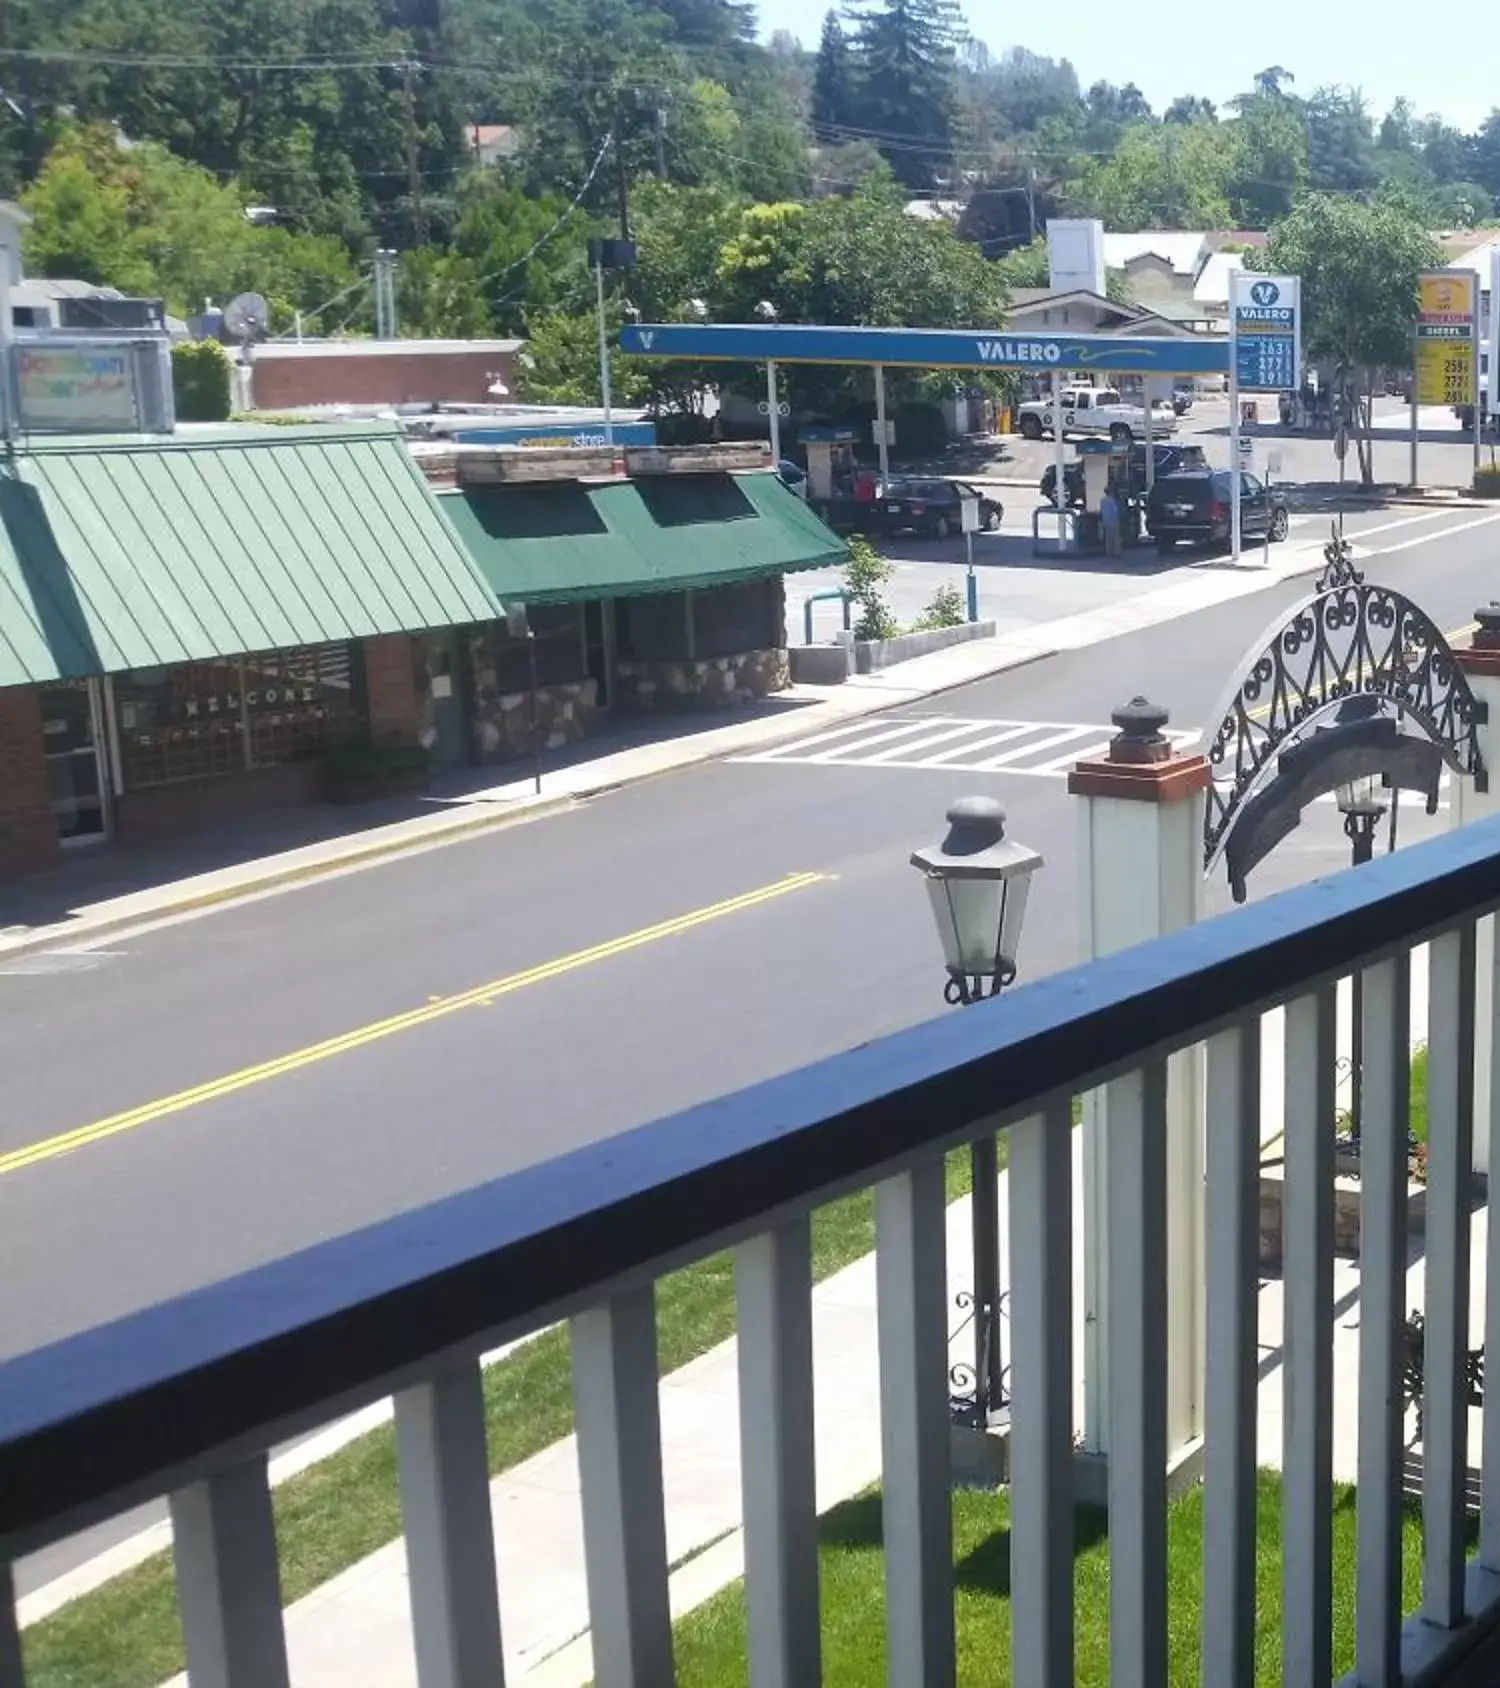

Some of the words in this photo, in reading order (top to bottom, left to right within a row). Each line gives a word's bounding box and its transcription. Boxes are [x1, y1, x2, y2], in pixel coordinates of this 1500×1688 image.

[1241, 308, 1290, 320] VALERO
[638, 331, 654, 349] V
[976, 341, 1061, 362] VALERO
